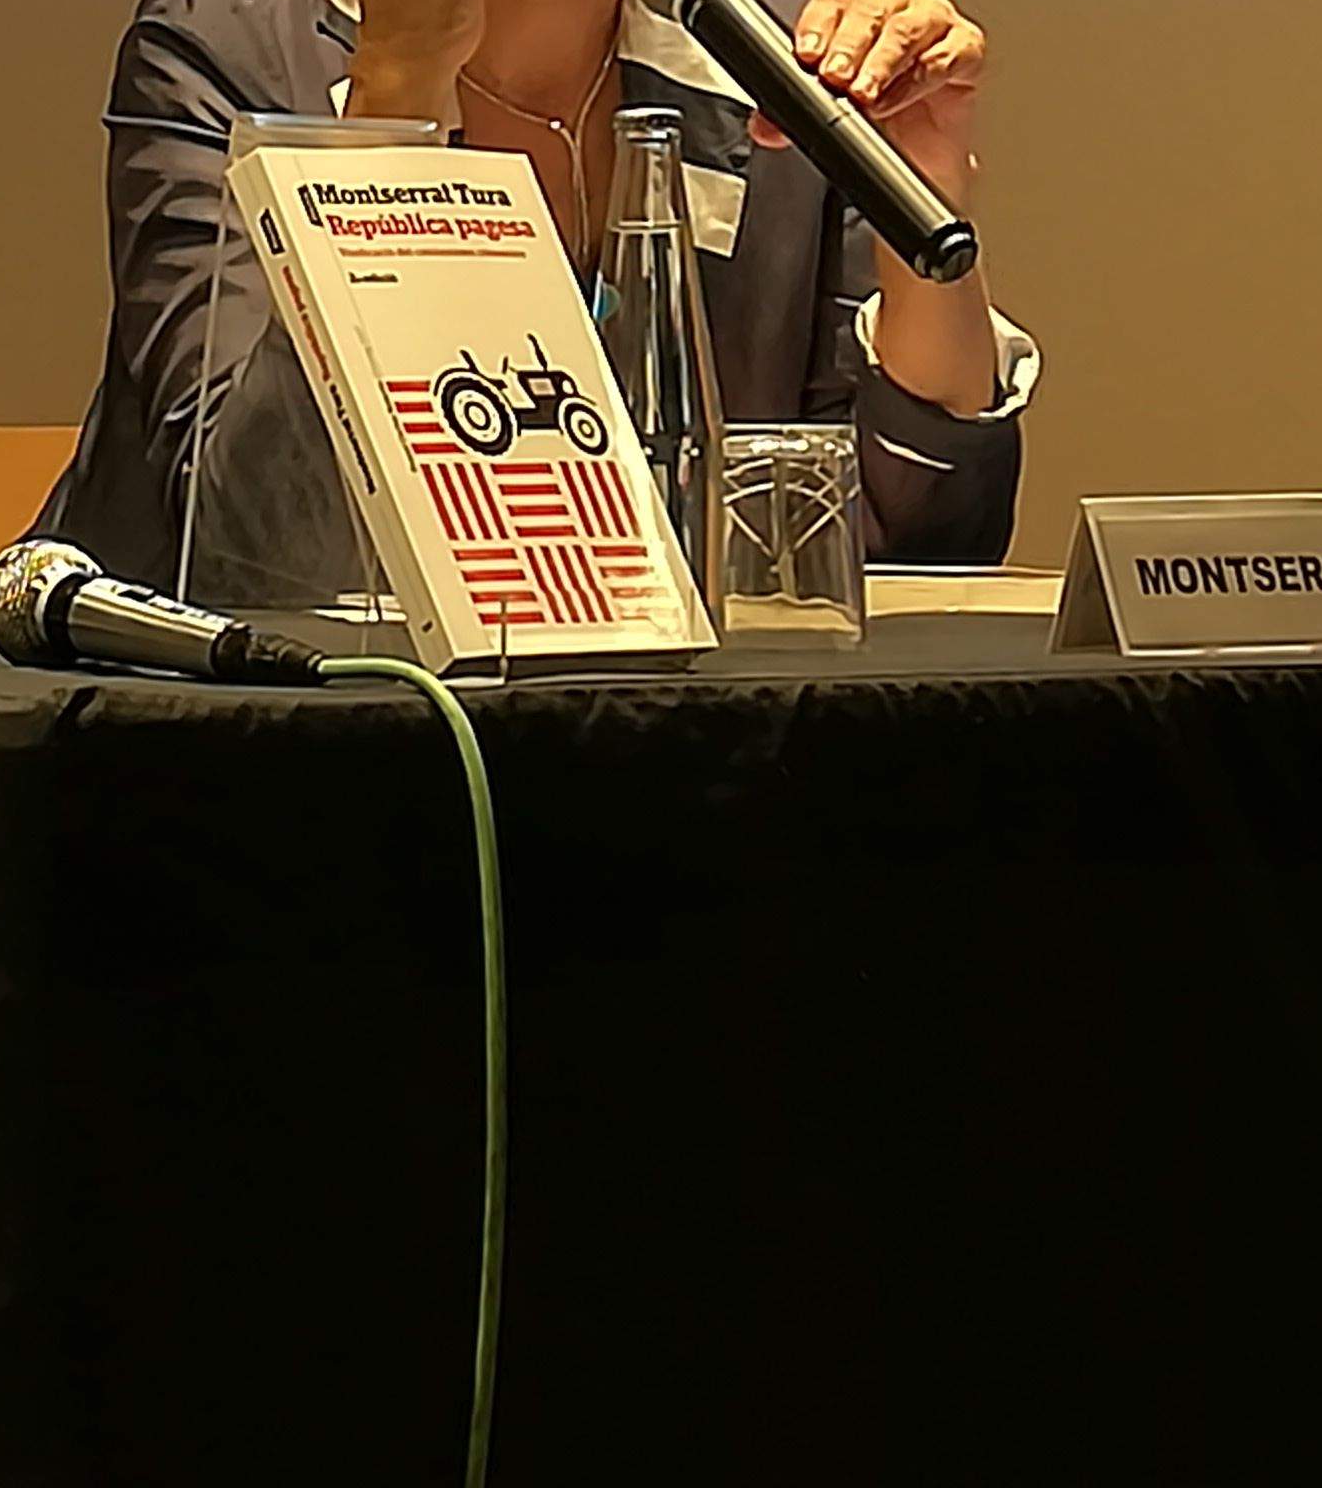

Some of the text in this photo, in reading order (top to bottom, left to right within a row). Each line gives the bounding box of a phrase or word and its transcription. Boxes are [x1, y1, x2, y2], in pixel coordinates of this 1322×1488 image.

[314, 183, 512, 207] Montserrat Tura
[326, 213, 536, 241] República pagesa
